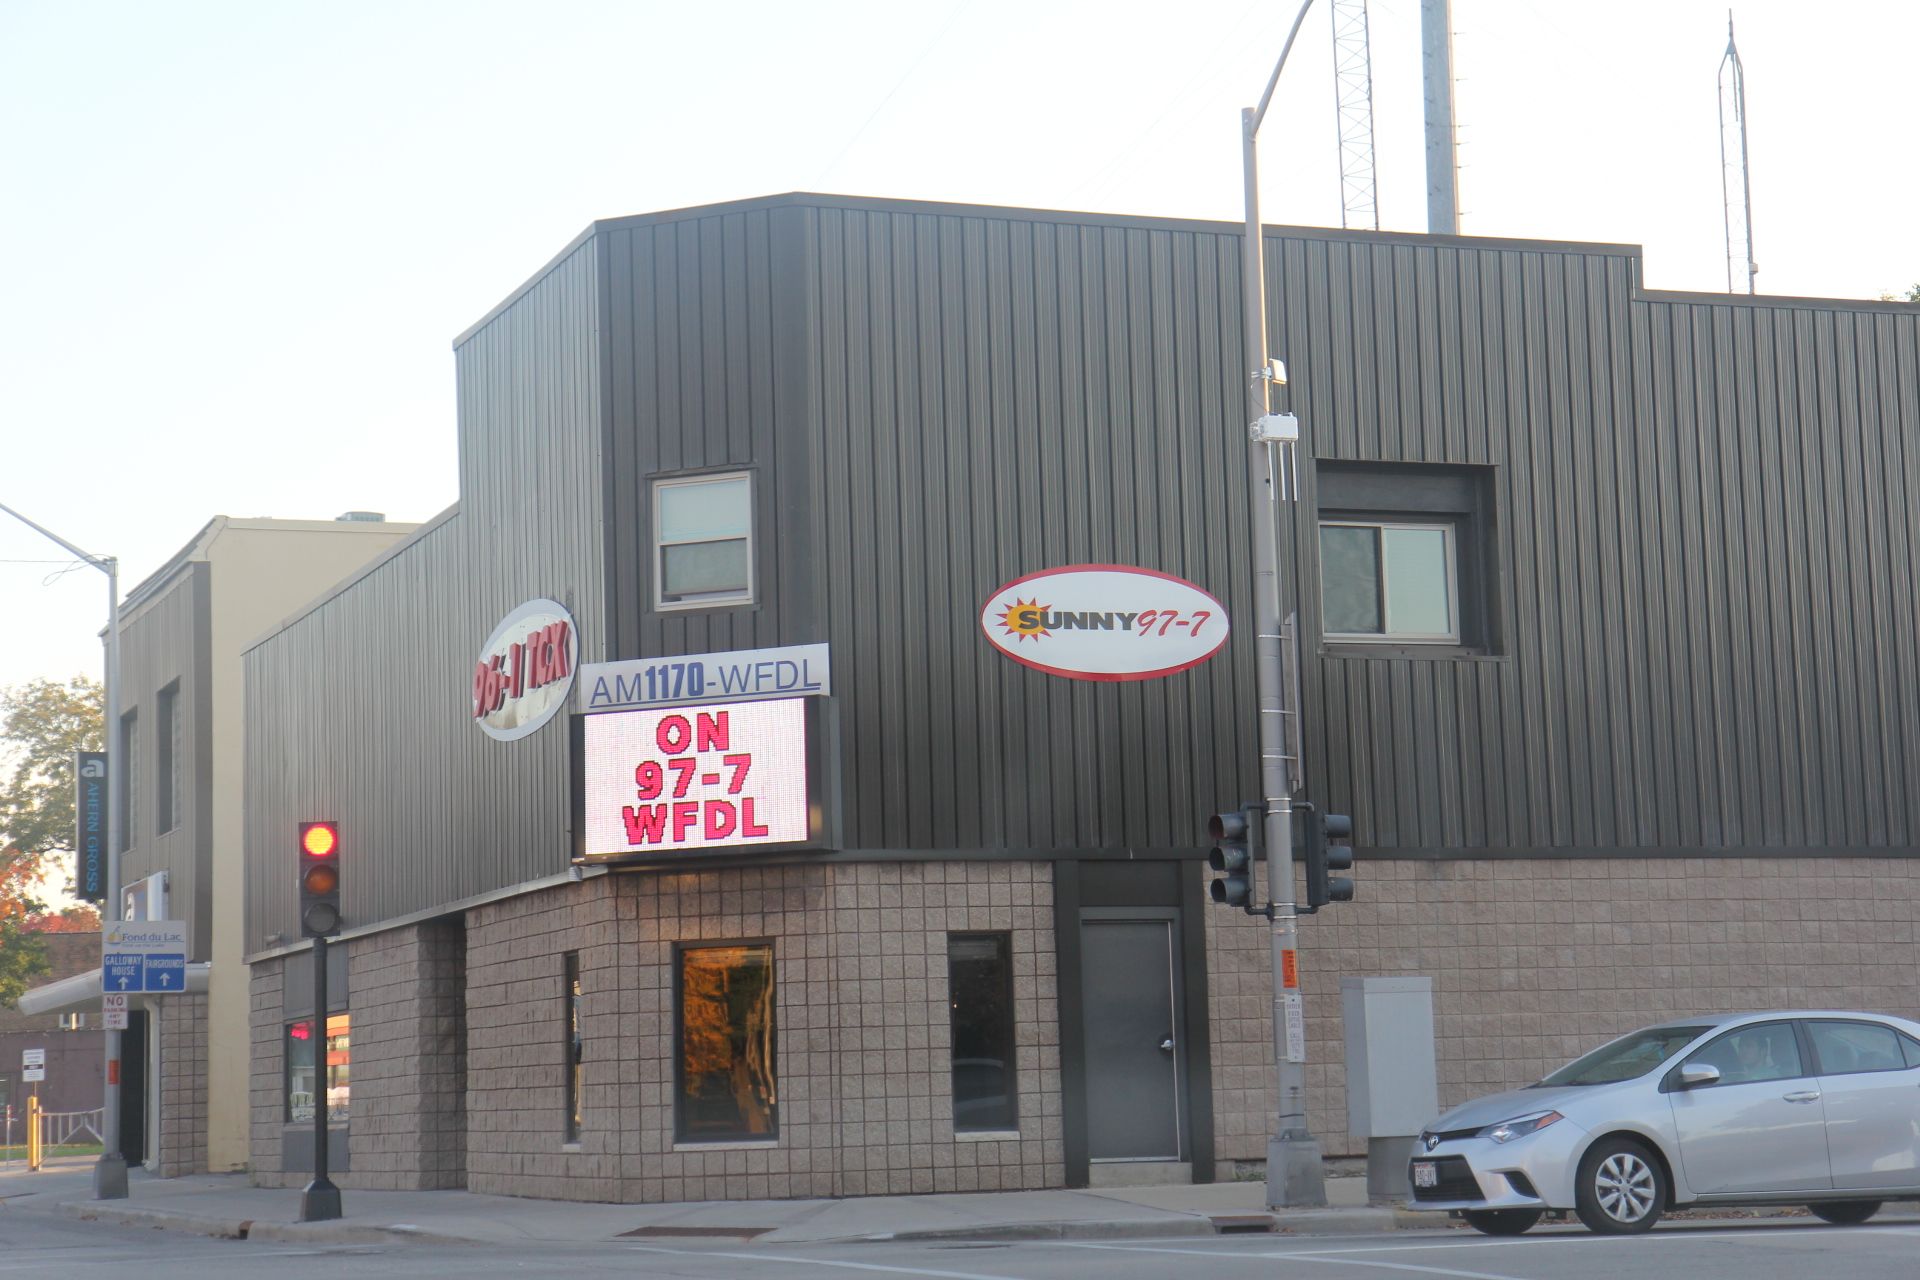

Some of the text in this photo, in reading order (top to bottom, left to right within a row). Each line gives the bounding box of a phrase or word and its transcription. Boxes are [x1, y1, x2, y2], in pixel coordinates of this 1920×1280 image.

[655, 710, 730, 755] ON
[635, 753, 752, 801] 97-7
[622, 796, 769, 846] WFDL
[86, 782, 101, 892] AHERN GROSS
[122, 933, 181, 941] Fond du Lac
[105, 955, 142, 966] GALLOWAY
[111, 965, 135, 976] HOUSE
[106, 996, 124, 1006] NO
